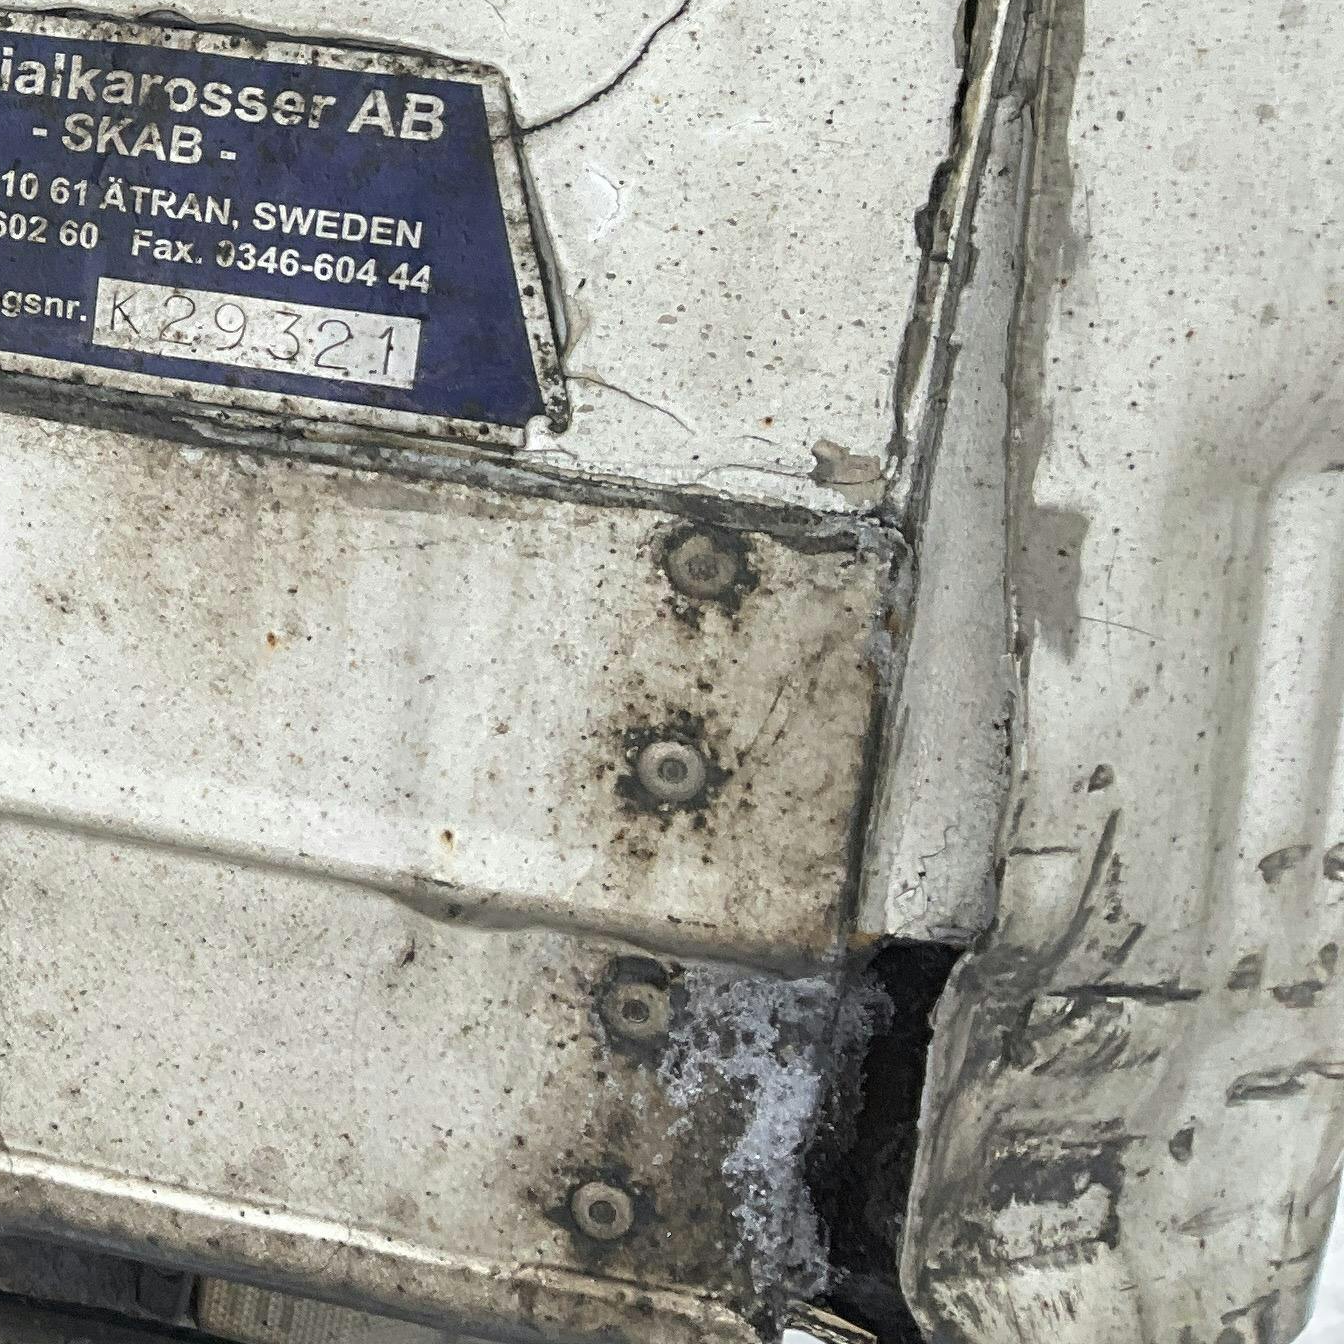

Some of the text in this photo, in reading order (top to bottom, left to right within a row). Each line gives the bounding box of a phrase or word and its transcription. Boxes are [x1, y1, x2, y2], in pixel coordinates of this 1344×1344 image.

[61, 112, 204, 164] SKAB
[346, 88, 446, 142] AB
[49, 177, 88, 206] 61
[99, 176, 240, 231] ÄTRAN,
[252, 201, 423, 249] SWEDEN
[59, 219, 99, 250] 60
[130, 228, 203, 265] Fax.
[214, 239, 378, 288] 0346-604
[387, 261, 432, 294] 44
[110, 290, 397, 377] K29321
